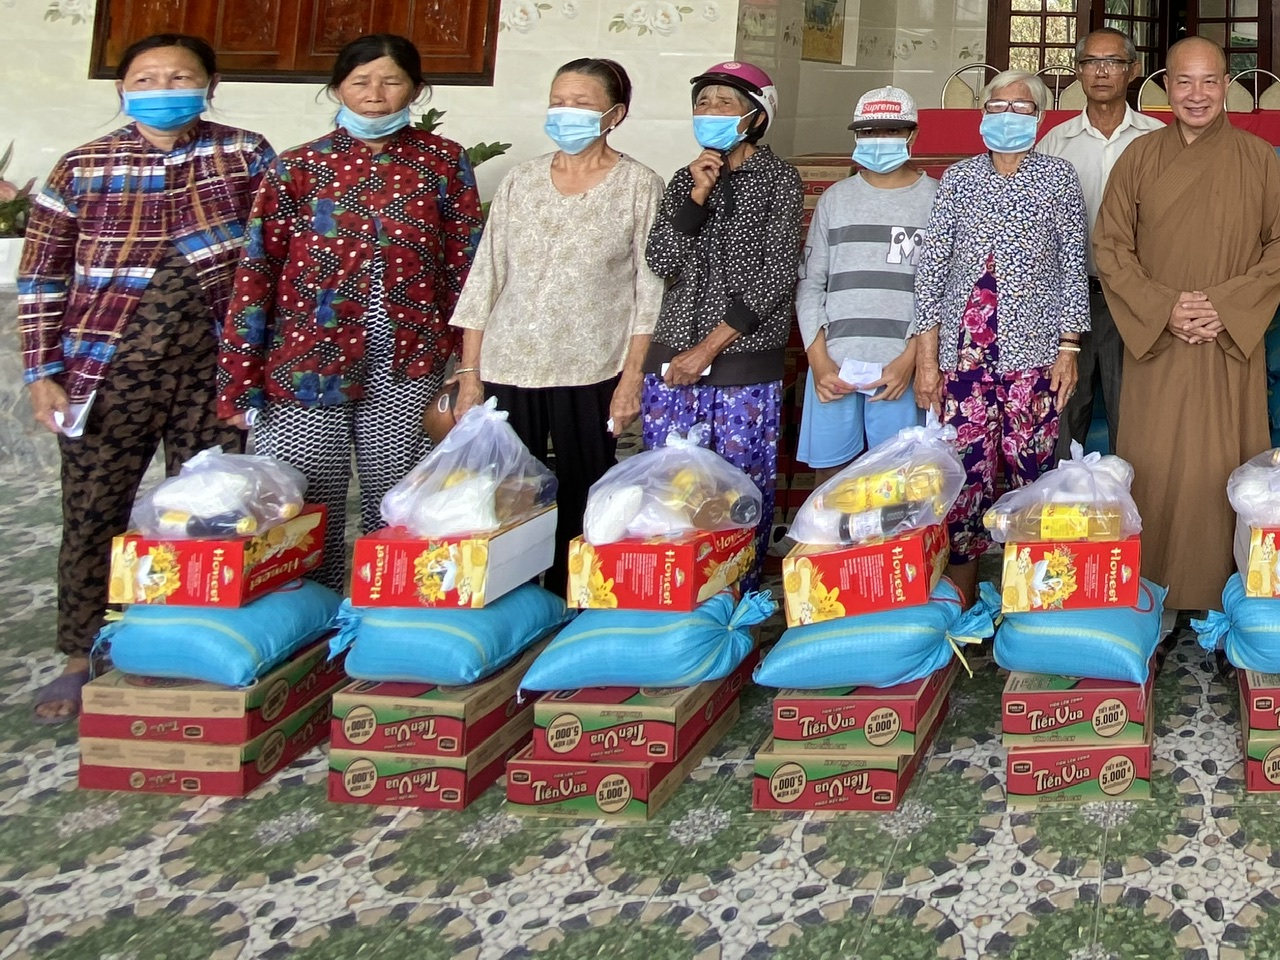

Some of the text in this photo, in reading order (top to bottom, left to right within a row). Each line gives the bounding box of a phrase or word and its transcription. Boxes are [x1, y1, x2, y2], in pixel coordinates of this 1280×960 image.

[370, 545, 384, 600] Honest
[664, 550, 676, 605] Honest
[891, 546, 906, 602] Honest
[1109, 548, 1122, 602] Honest
